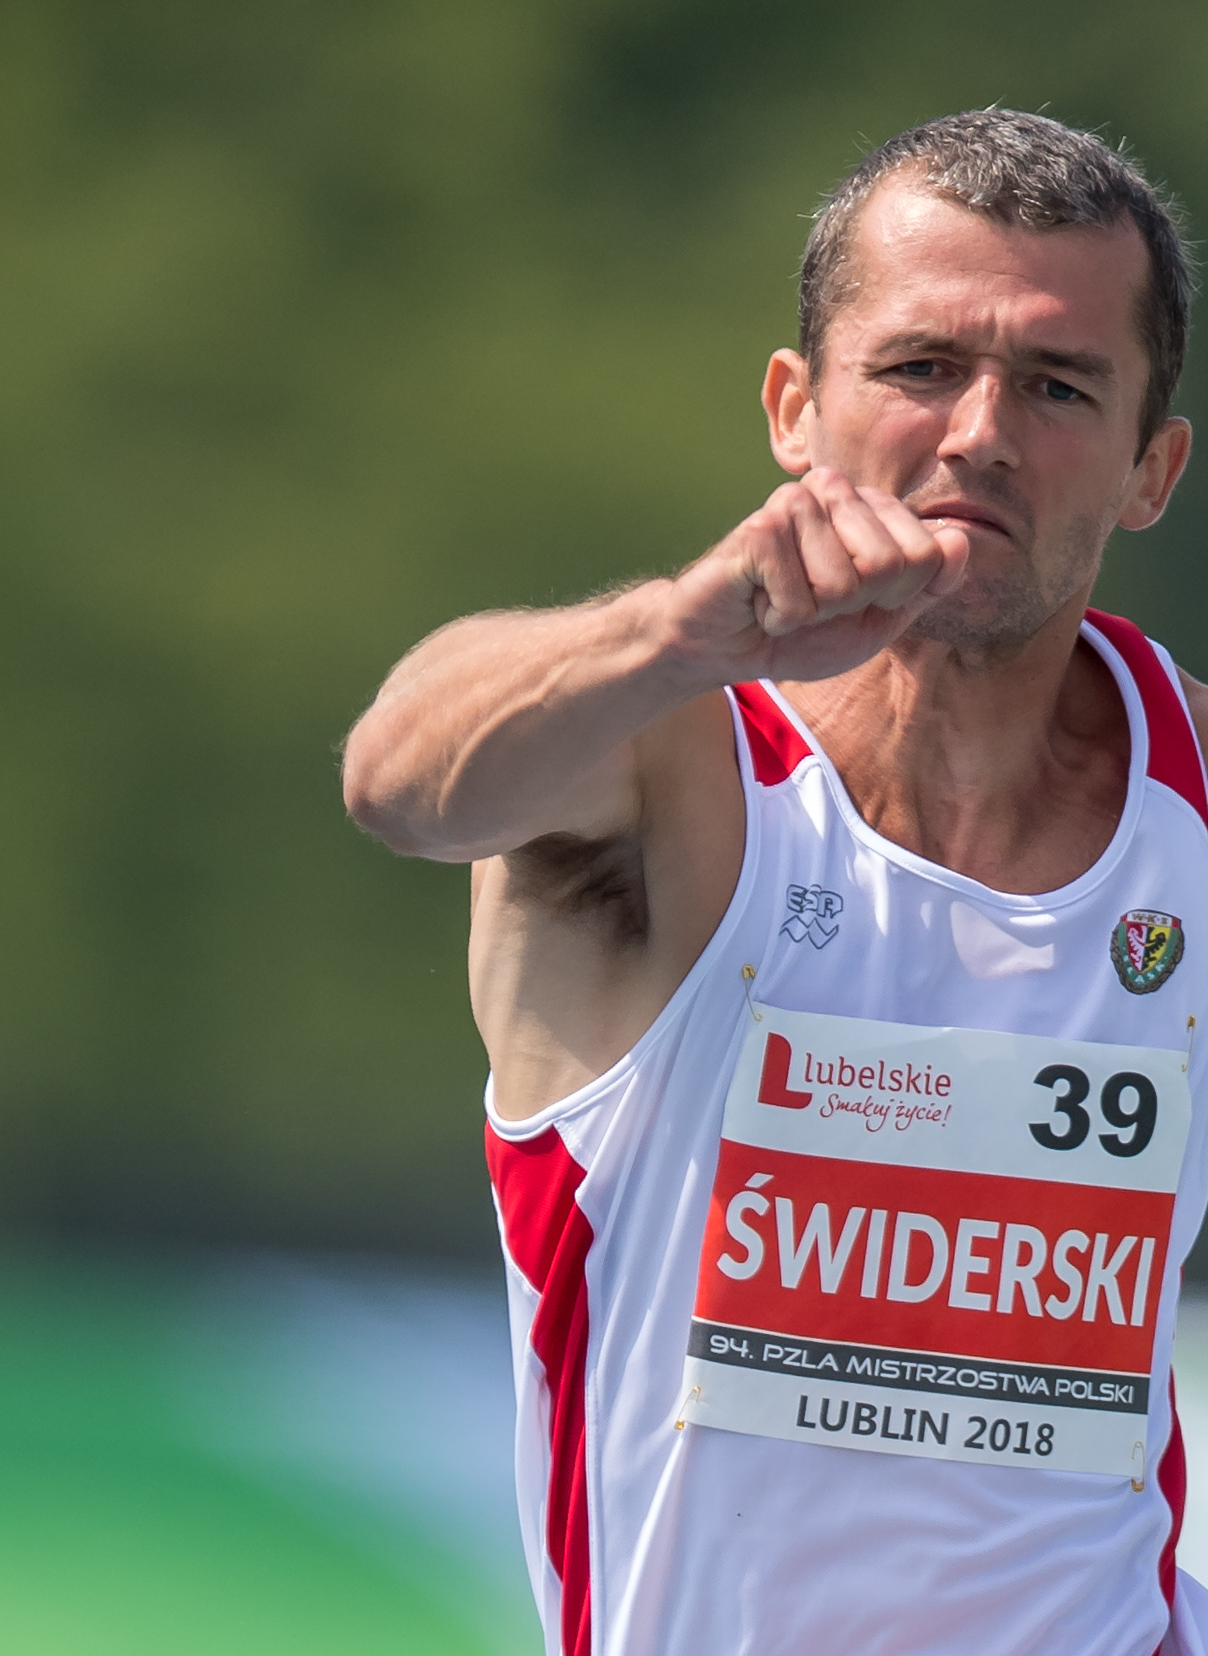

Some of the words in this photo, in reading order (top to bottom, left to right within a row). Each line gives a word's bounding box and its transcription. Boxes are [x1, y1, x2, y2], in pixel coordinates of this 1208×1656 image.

[804, 1052, 951, 1097] lubelskie
[819, 1093, 891, 1133] Smakuj
[895, 1100, 952, 1131] życie!
[1028, 1064, 1159, 1157] 39
[716, 1172, 1156, 1327] ŚWIDERSKI
[709, 1334, 754, 1360] 94.
[762, 1343, 839, 1372] PZLA
[845, 1356, 1050, 1397] MISTRZOSTWA
[1054, 1378, 1135, 1404] POLSKI
[795, 1395, 949, 1445] LUBLIN
[963, 1415, 1055, 1457] 2018
